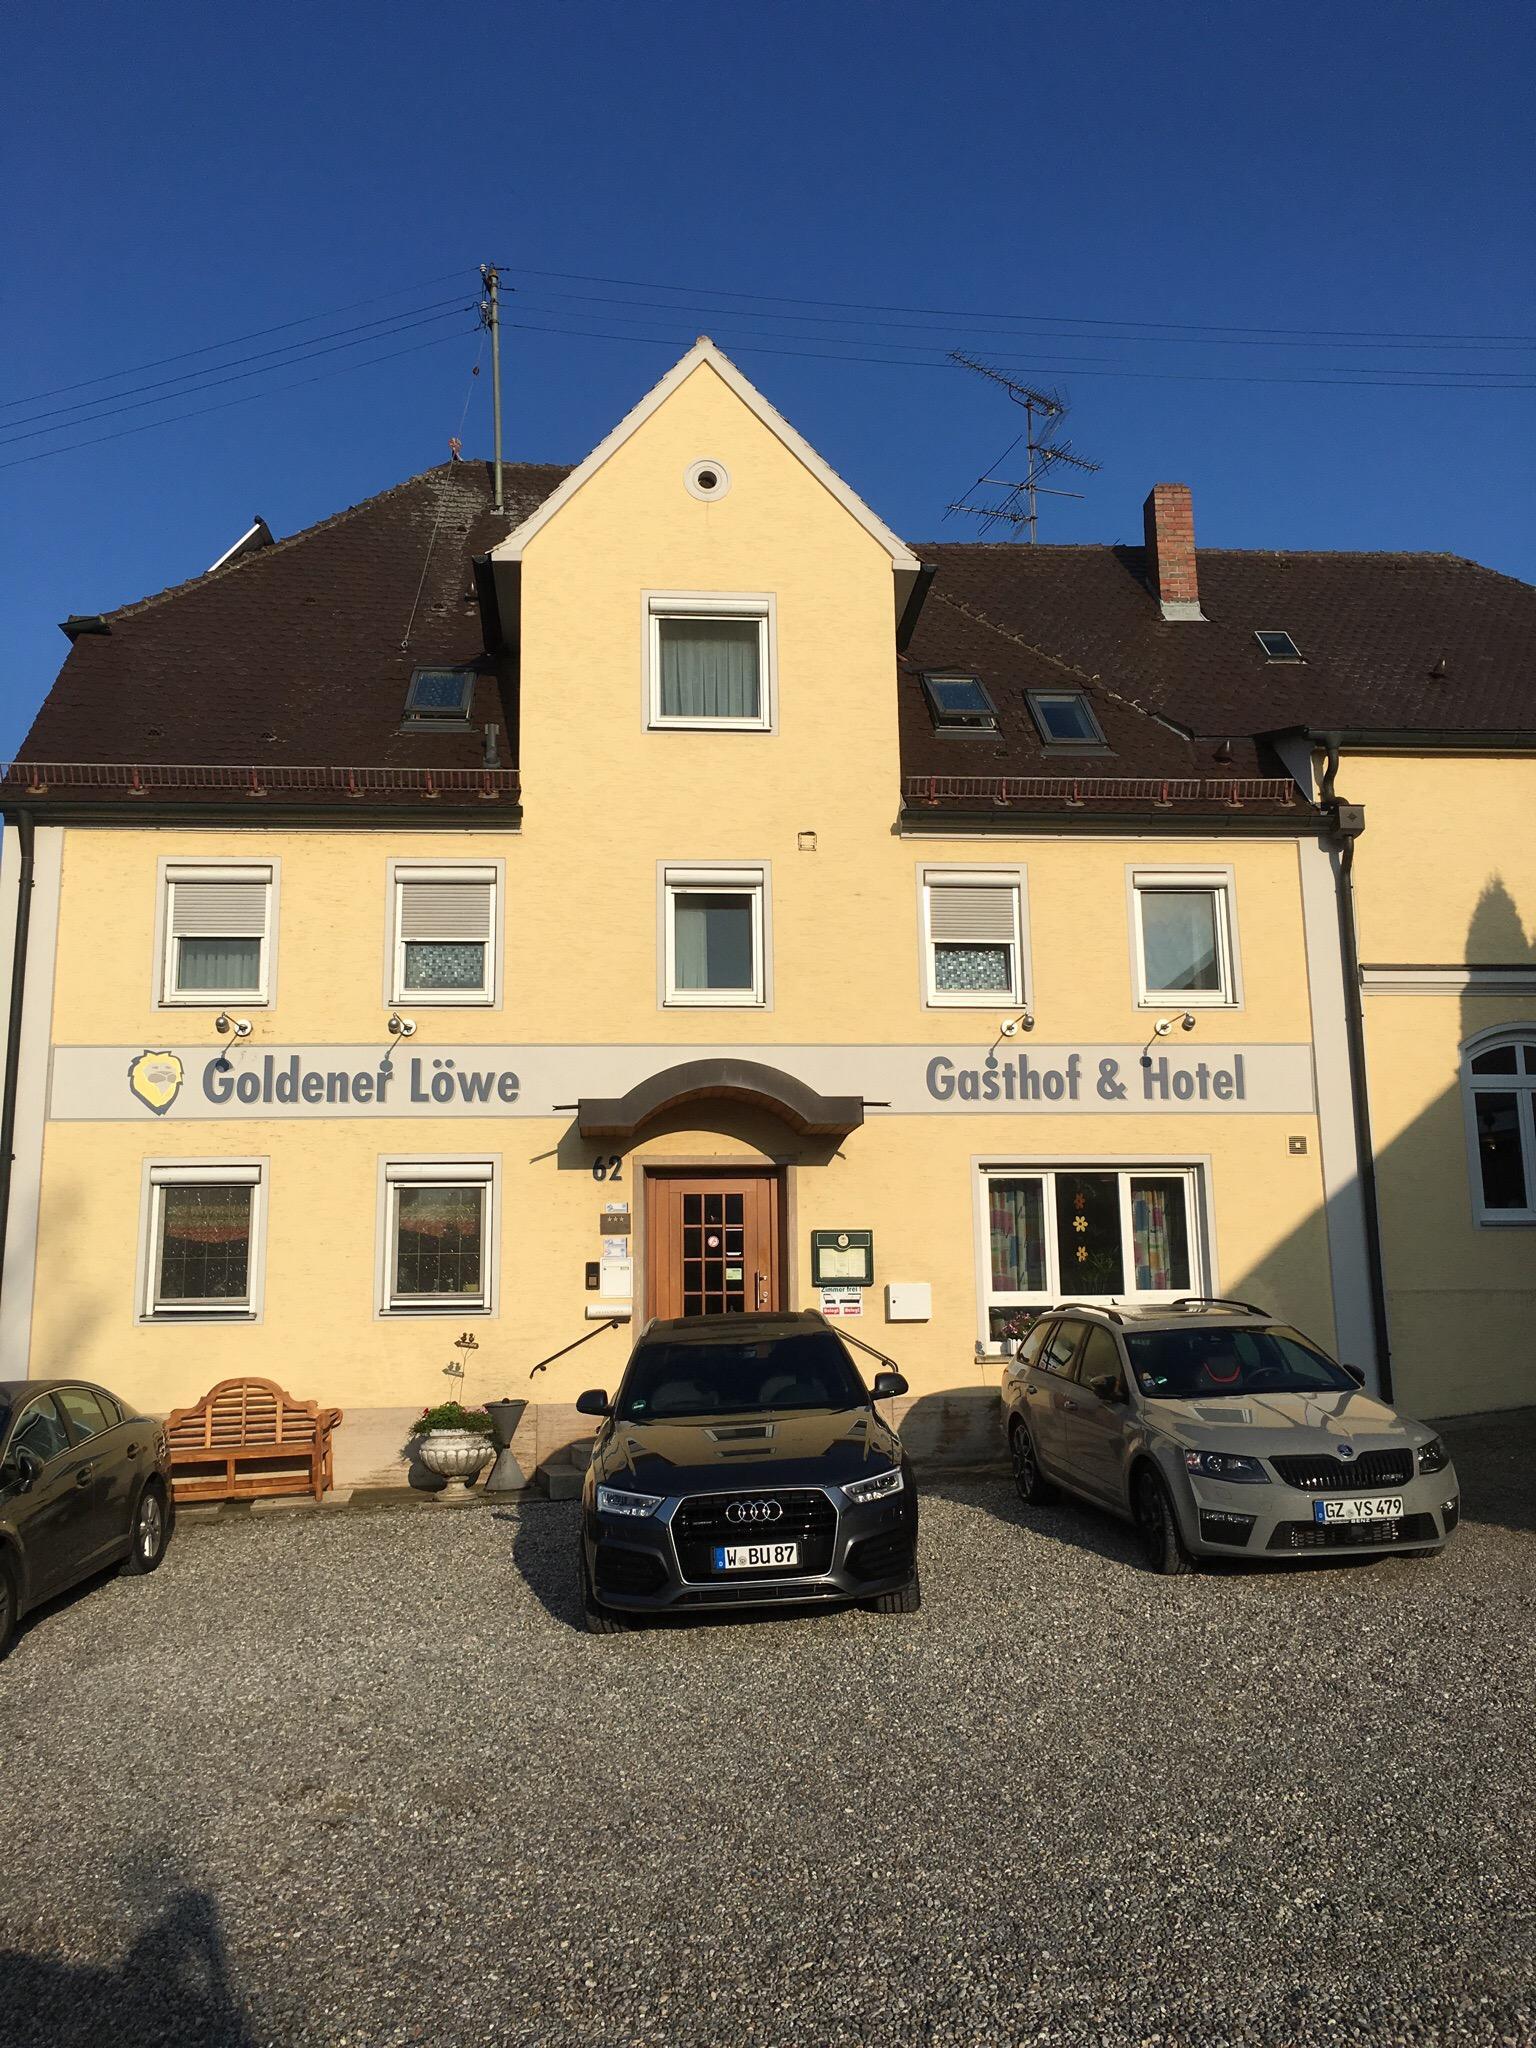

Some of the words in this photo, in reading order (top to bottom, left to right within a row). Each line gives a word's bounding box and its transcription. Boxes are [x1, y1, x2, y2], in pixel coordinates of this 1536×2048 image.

[202, 1054, 393, 1104] Goldener
[410, 1057, 519, 1103] Löwe
[926, 1053, 1080, 1101] Gasthof
[1096, 1058, 1128, 1100] &
[1142, 1053, 1245, 1100] Hotel
[593, 1155, 622, 1181] 62
[846, 1285, 858, 1293] frei
[1325, 1502, 1345, 1518] GZ
[1354, 1501, 1373, 1516] YS
[1376, 1499, 1402, 1515] 479
[727, 1549, 737, 1566] W
[748, 1547, 771, 1564] BU
[774, 1545, 794, 1563] 87
